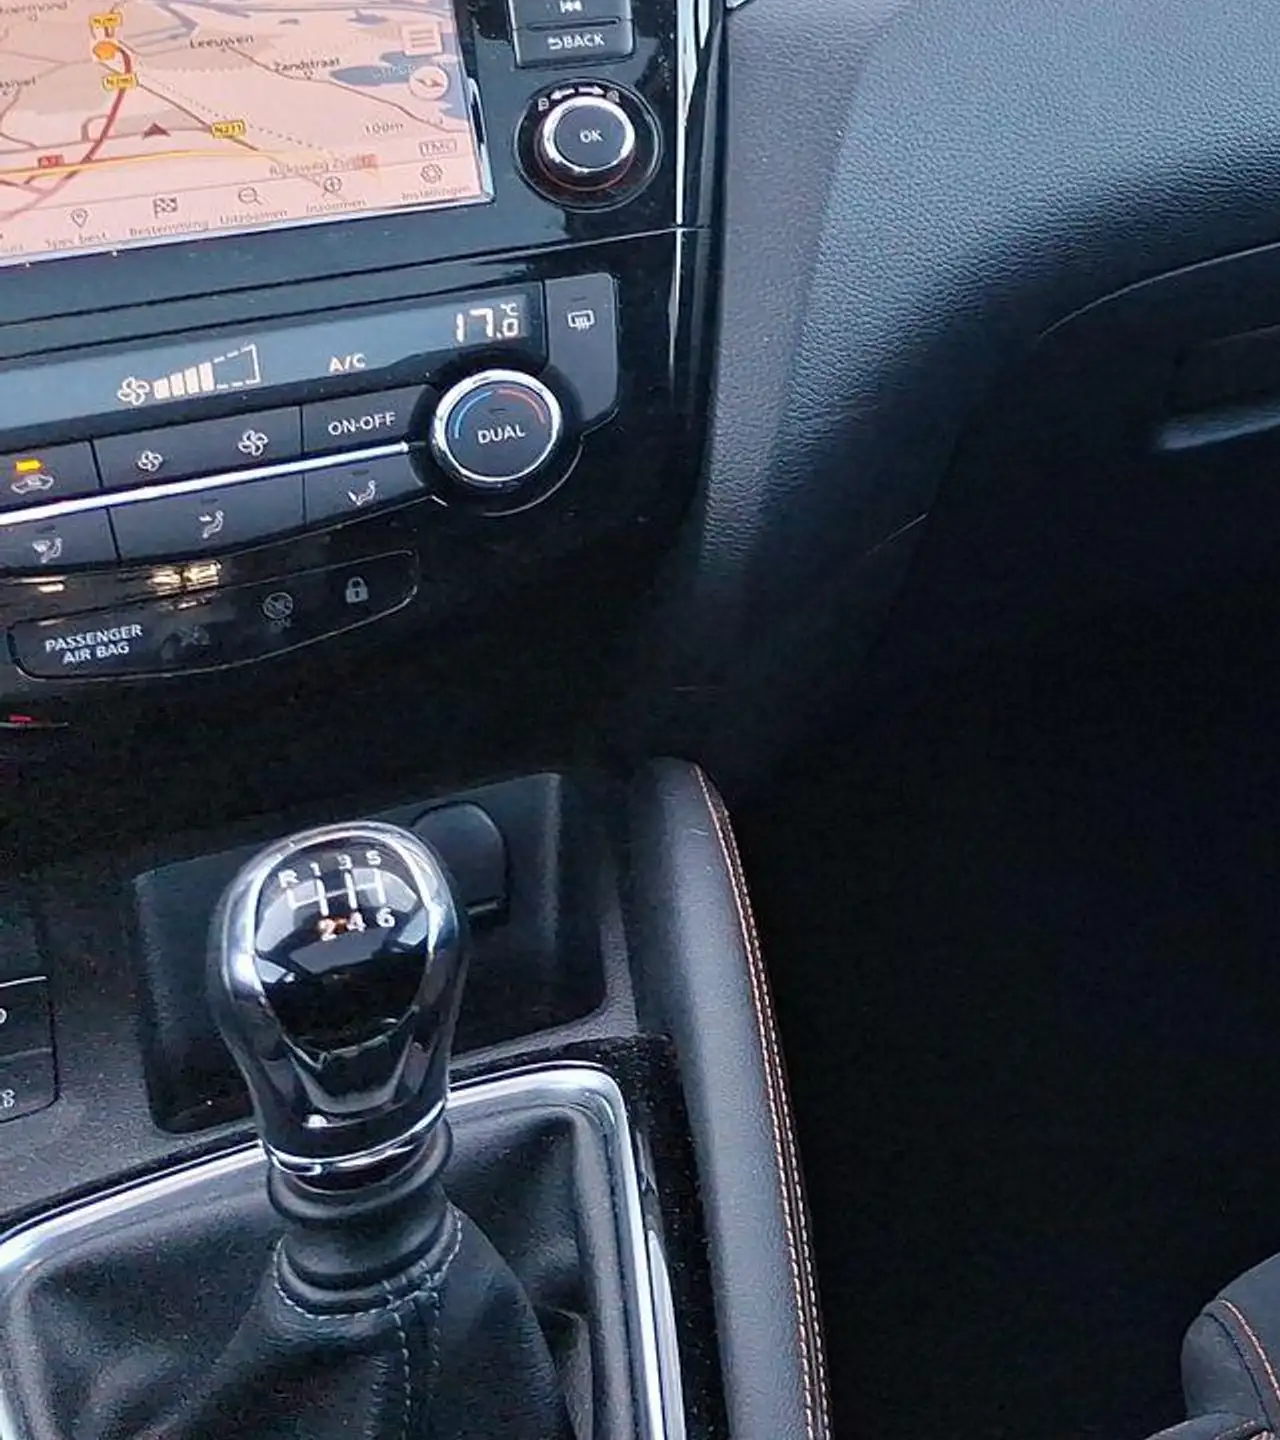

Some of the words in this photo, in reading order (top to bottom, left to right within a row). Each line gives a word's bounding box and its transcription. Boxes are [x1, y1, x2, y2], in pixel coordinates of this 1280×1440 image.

[189, 34, 254, 50] Leeuwen
[564, 33, 606, 49] BACK
[580, 130, 605, 143] OK
[219, 209, 288, 225] Uitzoomen
[129, 218, 210, 237] Bestemming
[455, 307, 519, 343] 17.0
[329, 353, 366, 373] A/C
[477, 427, 526, 444] DUAL
[45, 624, 143, 652] PASSENGER
[62, 648, 92, 664] AIR
[95, 641, 130, 659] BAG
[310, 862, 321, 877] 1
[337, 854, 353, 870] 3
[319, 918, 337, 941] 2
[346, 911, 366, 932] 4
[376, 907, 396, 928] 6
